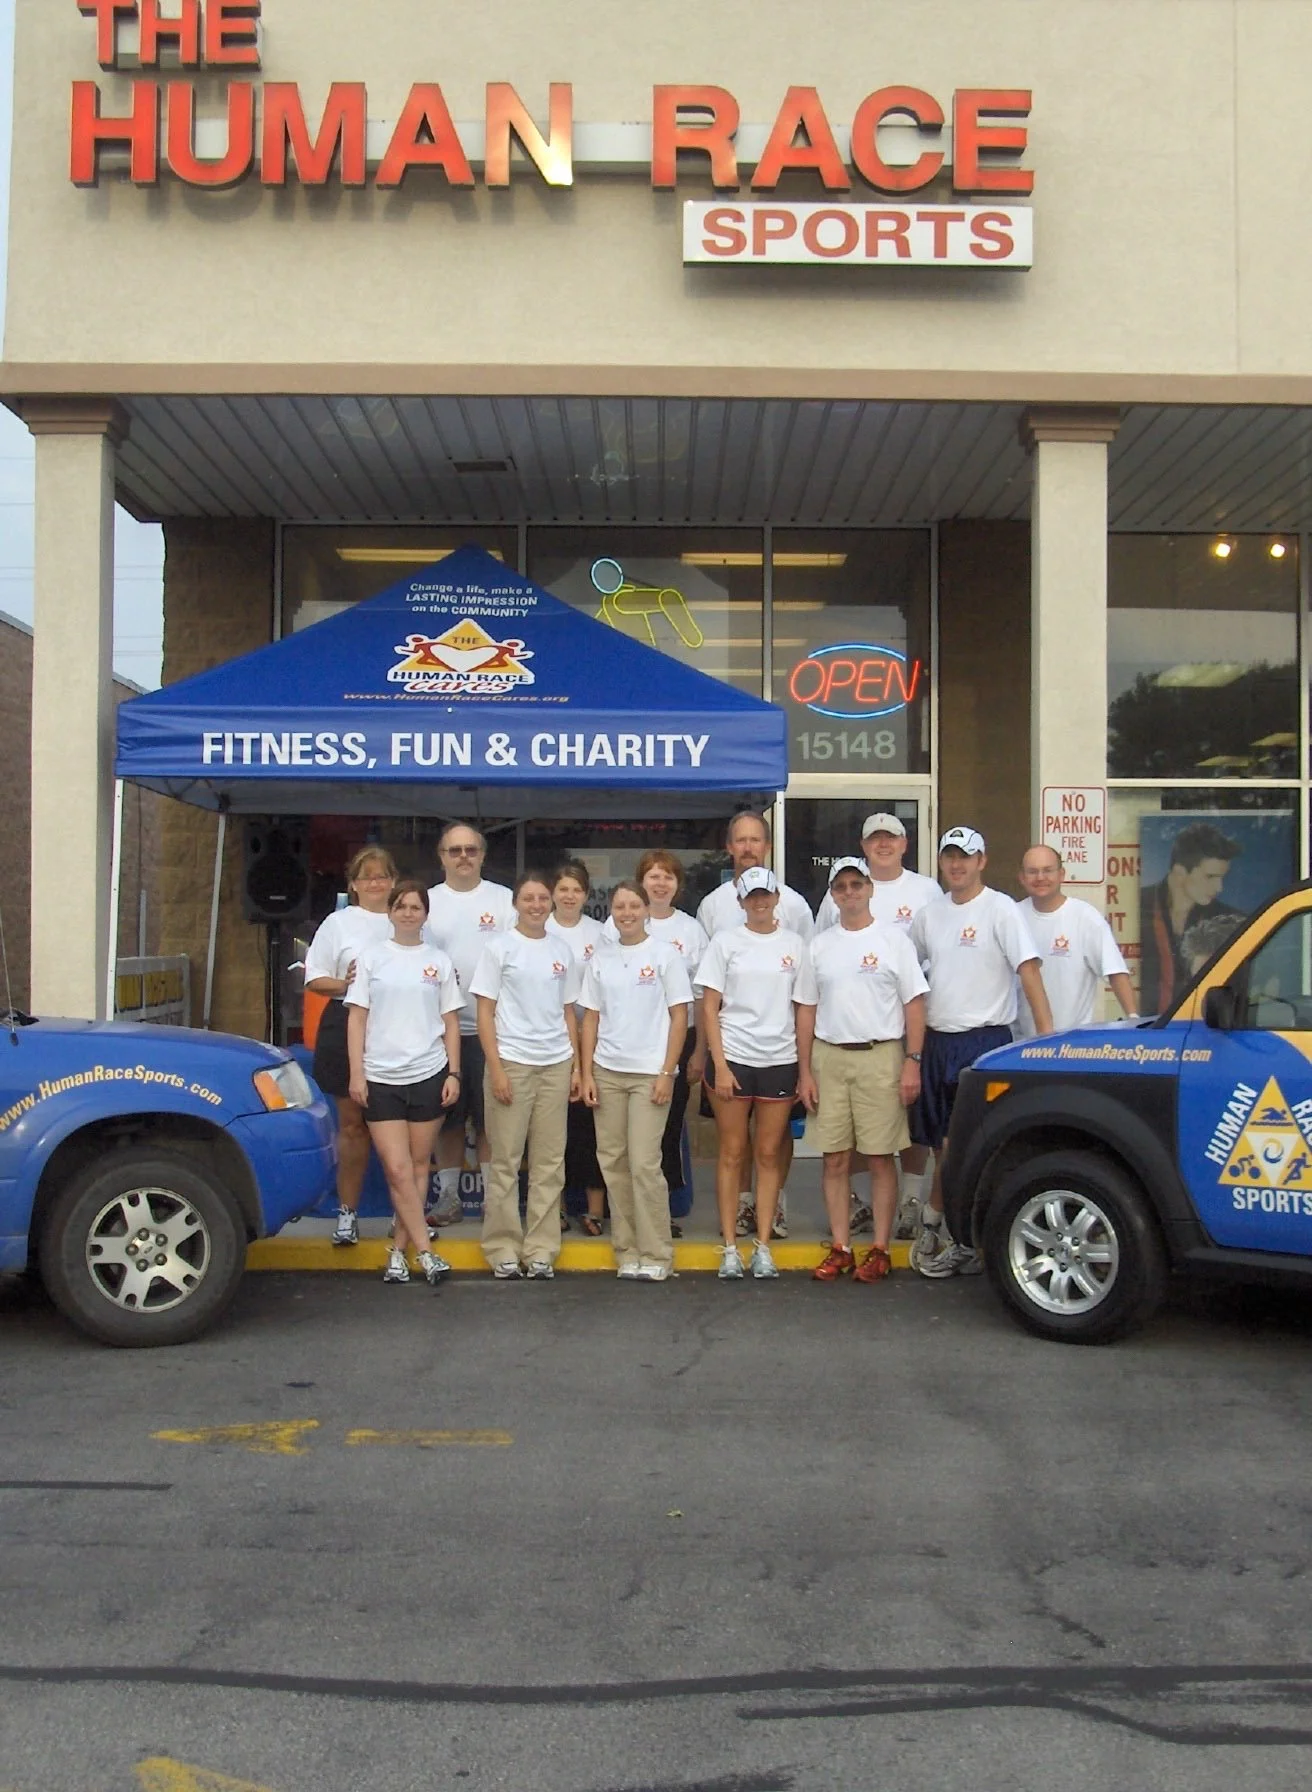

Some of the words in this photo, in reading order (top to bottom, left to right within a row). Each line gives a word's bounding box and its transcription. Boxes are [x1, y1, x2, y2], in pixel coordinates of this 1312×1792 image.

[76, 0, 262, 70] THE
[70, 80, 574, 188] HUMAN
[651, 84, 1035, 194] RACE
[701, 208, 1015, 260] SPORTS
[410, 583, 453, 593] Change
[466, 585, 488, 595] life,
[491, 587, 523, 595] make
[405, 593, 458, 603] LASTING
[461, 595, 538, 606] IMPRESSION
[429, 605, 448, 613] the
[451, 606, 529, 617] COMMUNITY
[452, 636, 480, 645] THE
[393, 671, 471, 682] HUMAN
[477, 673, 529, 683] RACE
[408, 679, 508, 693] cares
[788, 658, 921, 704] OPEN
[343, 693, 569, 703] www.HumanRaceCares.org
[202, 732, 377, 769] FITNESS,
[391, 733, 472, 766] FUN
[485, 732, 518, 766] &
[531, 733, 709, 767] CHARITY
[796, 729, 897, 760] 15148
[1062, 794, 1086, 812] NO
[1046, 815, 1102, 834] PARKING
[1061, 836, 1087, 849] FIRE
[812, 857, 831, 867] THE
[1020, 1044, 1212, 1064] www.HumanRaceSports.com
[1204, 1082, 1259, 1166] HUMAN
[1232, 1186, 1312, 1216] SPORTS
